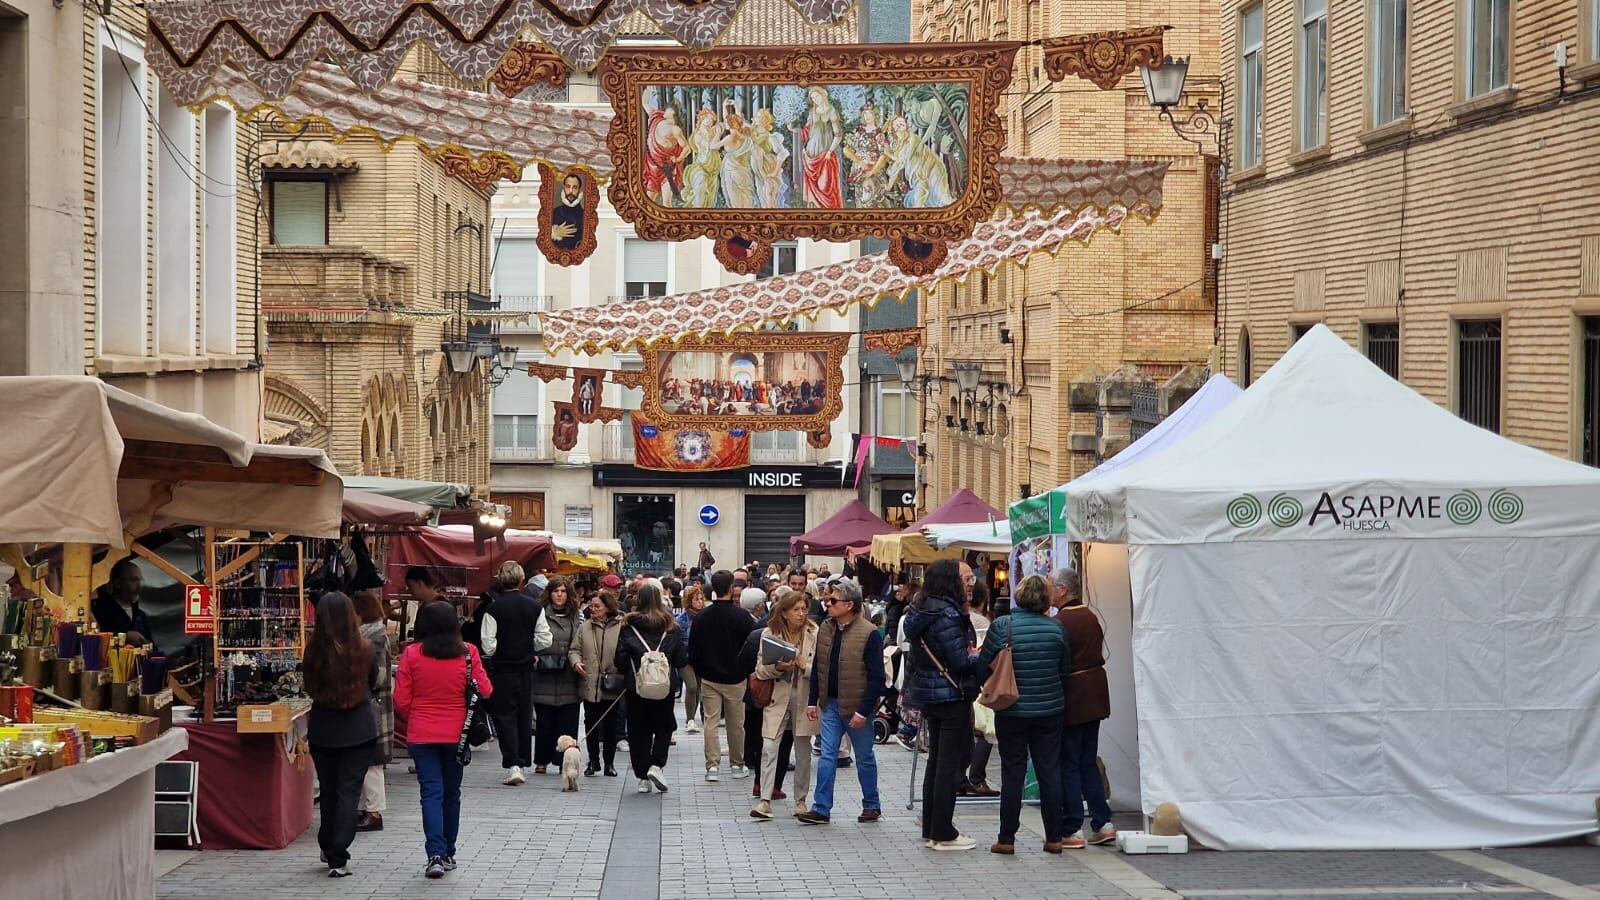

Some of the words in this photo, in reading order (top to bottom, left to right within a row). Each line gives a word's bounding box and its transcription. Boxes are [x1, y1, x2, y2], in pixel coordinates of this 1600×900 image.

[749, 472, 803, 487] INSIDE
[1308, 491, 1441, 526] ASAPME
[1343, 520, 1391, 531] HUESCA
[622, 560, 651, 568] tudio
